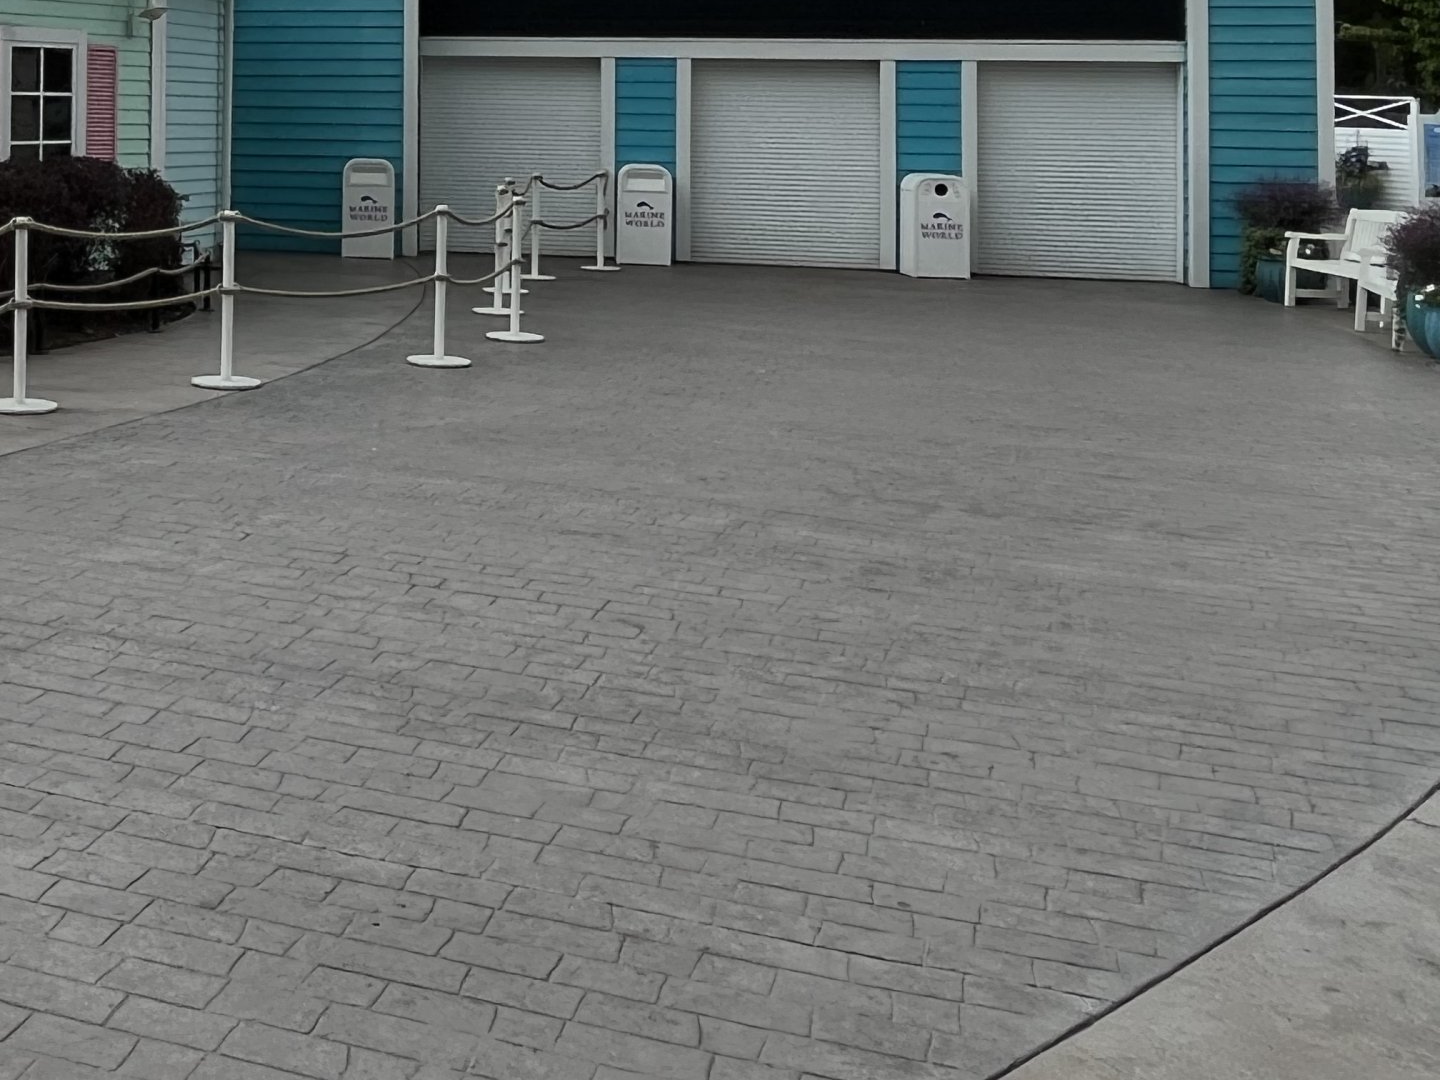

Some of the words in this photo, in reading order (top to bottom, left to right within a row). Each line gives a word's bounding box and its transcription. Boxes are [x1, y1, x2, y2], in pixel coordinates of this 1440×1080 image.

[348, 205, 388, 214] MARINE
[349, 213, 388, 222] WORLD
[624, 211, 665, 220] MARINE
[624, 219, 665, 228] WORLD
[920, 222, 964, 231] MARINE
[921, 230, 964, 240] WORLD
